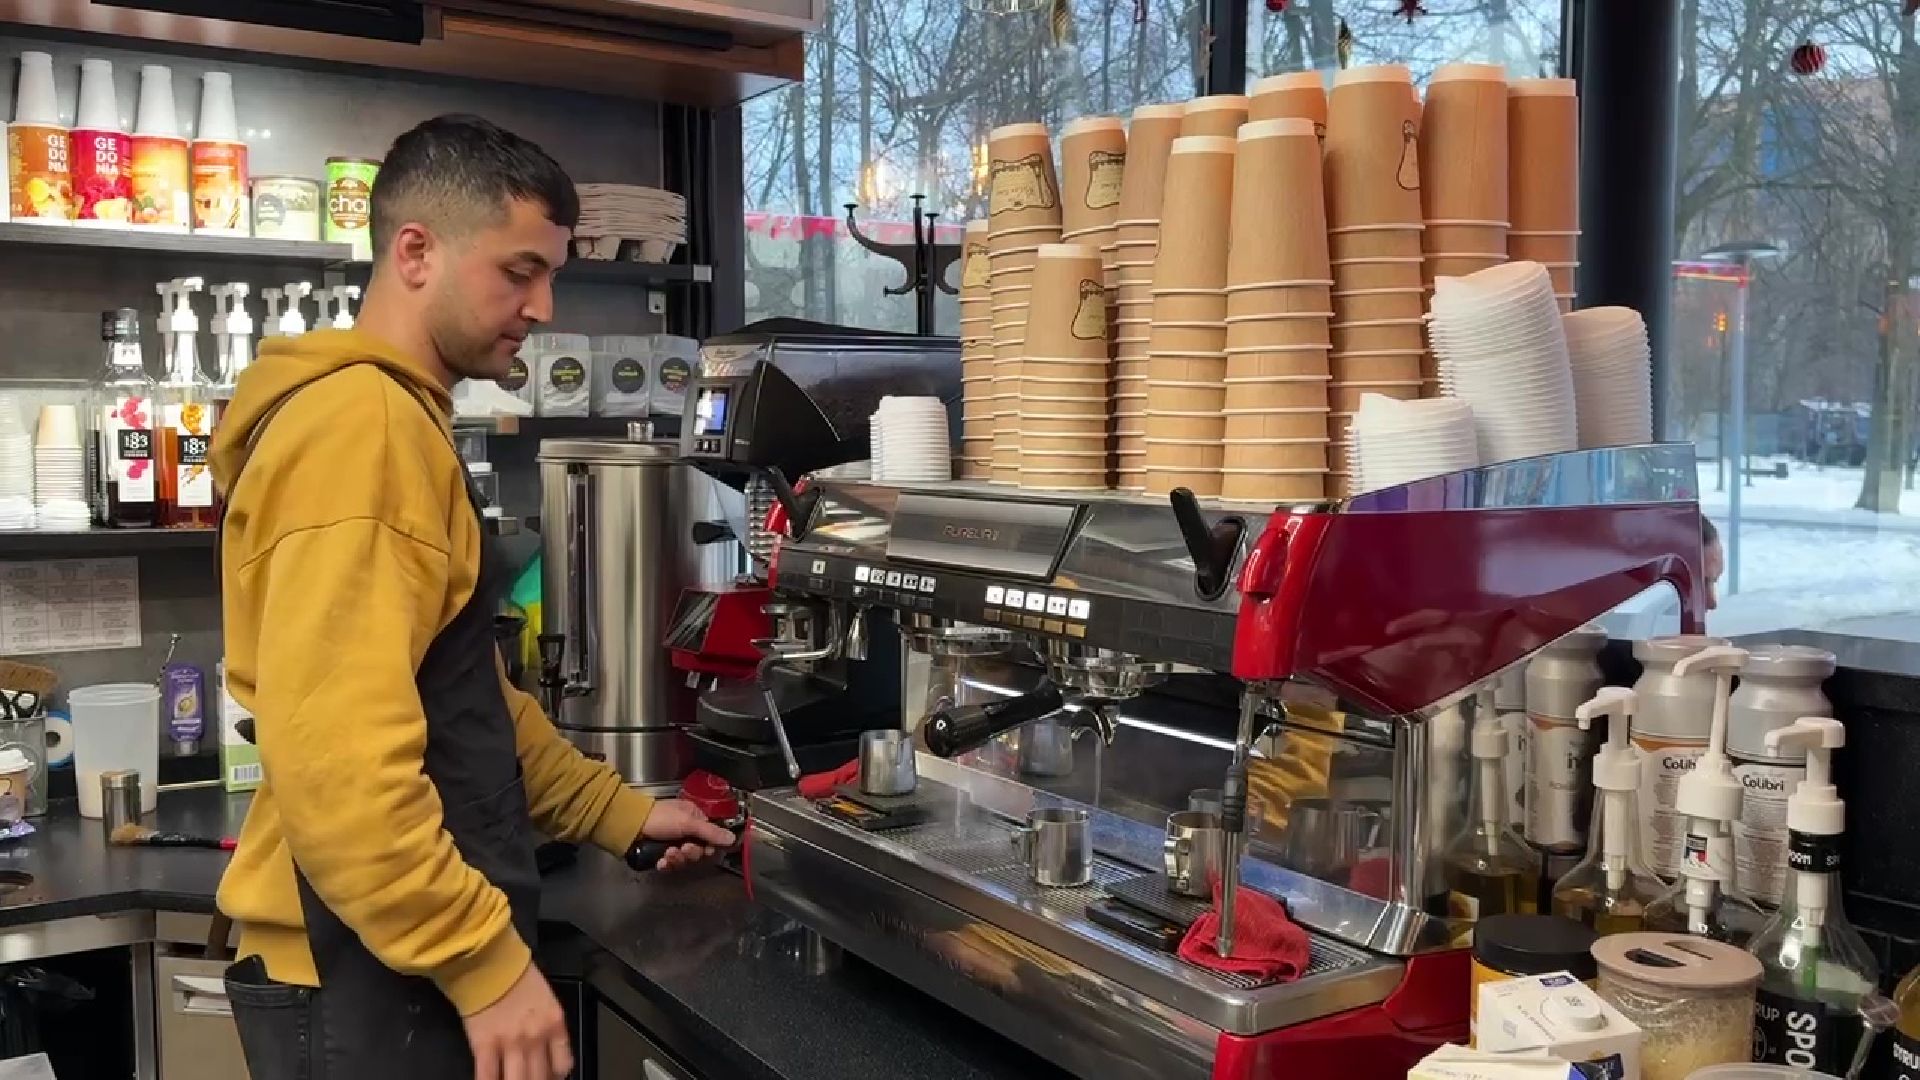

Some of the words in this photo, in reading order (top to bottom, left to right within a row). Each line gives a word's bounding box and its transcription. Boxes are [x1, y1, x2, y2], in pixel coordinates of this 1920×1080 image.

[47, 134, 65, 148] GE
[95, 137, 116, 150] GE
[47, 148, 67, 160] DO
[95, 150, 118, 163] DO
[95, 163, 119, 176] NIA
[1662, 756, 1696, 770] Colib
[1742, 774, 1784, 792] Colibri
[1787, 849, 1812, 866] OOM
